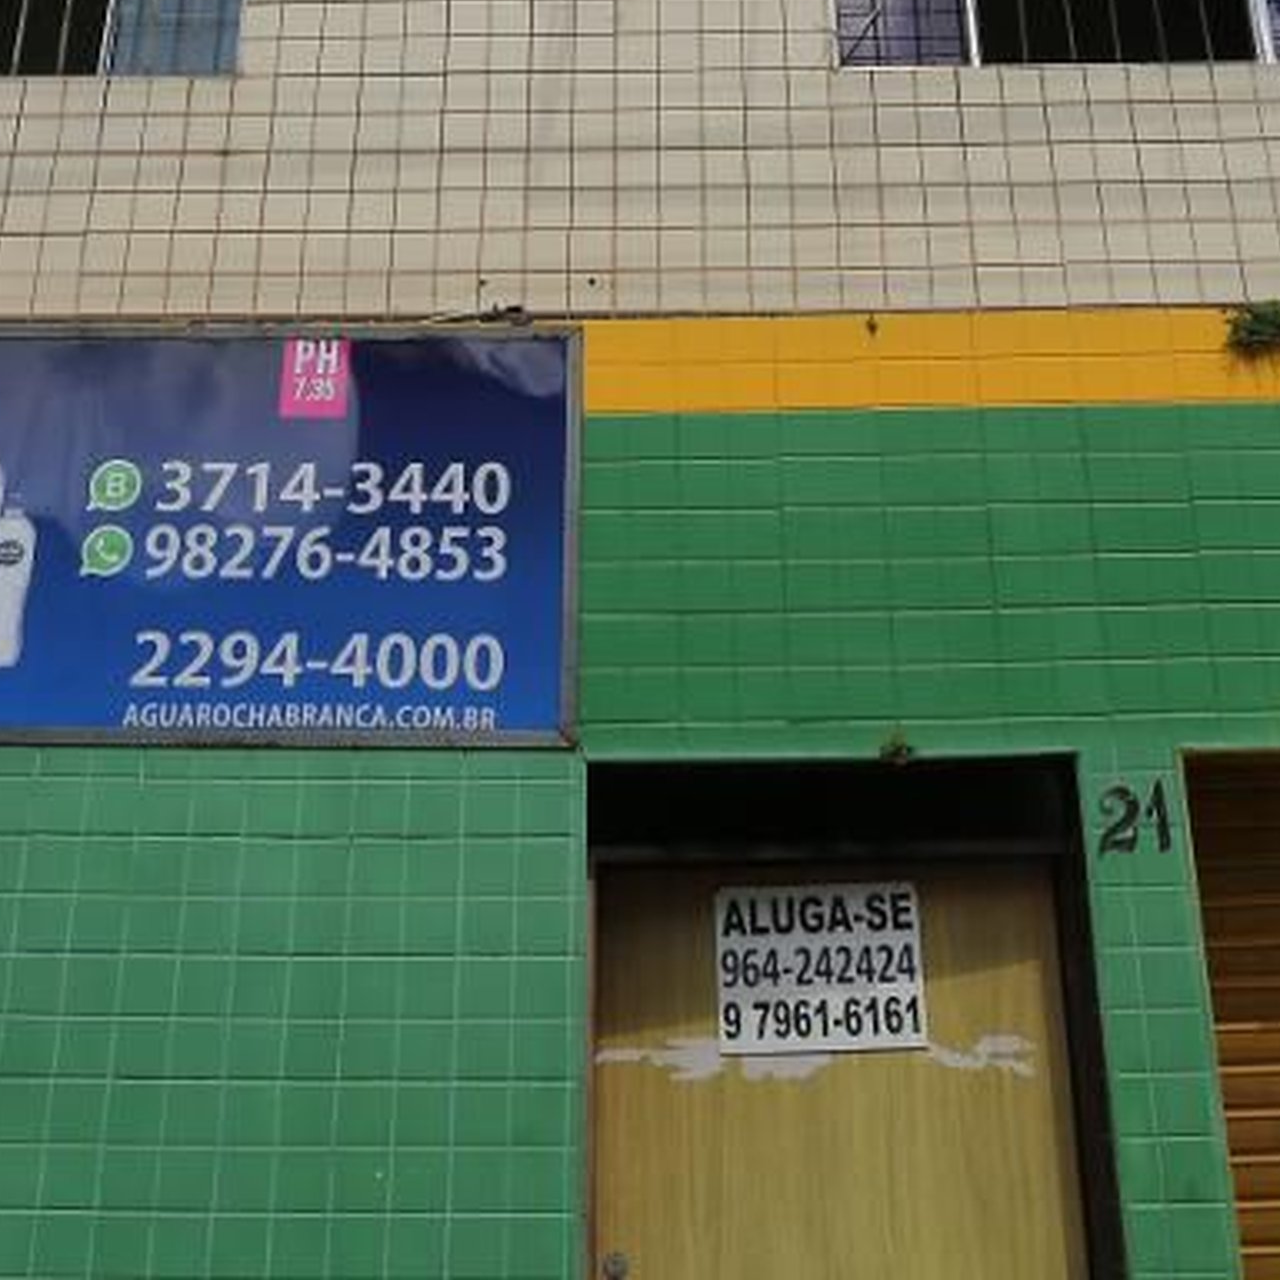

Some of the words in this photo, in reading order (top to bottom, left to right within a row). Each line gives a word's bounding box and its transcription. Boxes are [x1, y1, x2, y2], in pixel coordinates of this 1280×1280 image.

[294, 339, 339, 374] PH
[155, 461, 511, 515] 3714-3440
[145, 525, 509, 581] 98276-4853
[130, 630, 504, 691] 2294-4000
[122, 702, 497, 732] AGUAROCHABRANCA.COM.BR
[1097, 777, 1172, 856] 21
[722, 892, 914, 938] ALUGA-SE
[721, 942, 916, 989] 964-242424
[723, 1002, 742, 1039] 9
[752, 994, 921, 1040] 7961-6161
